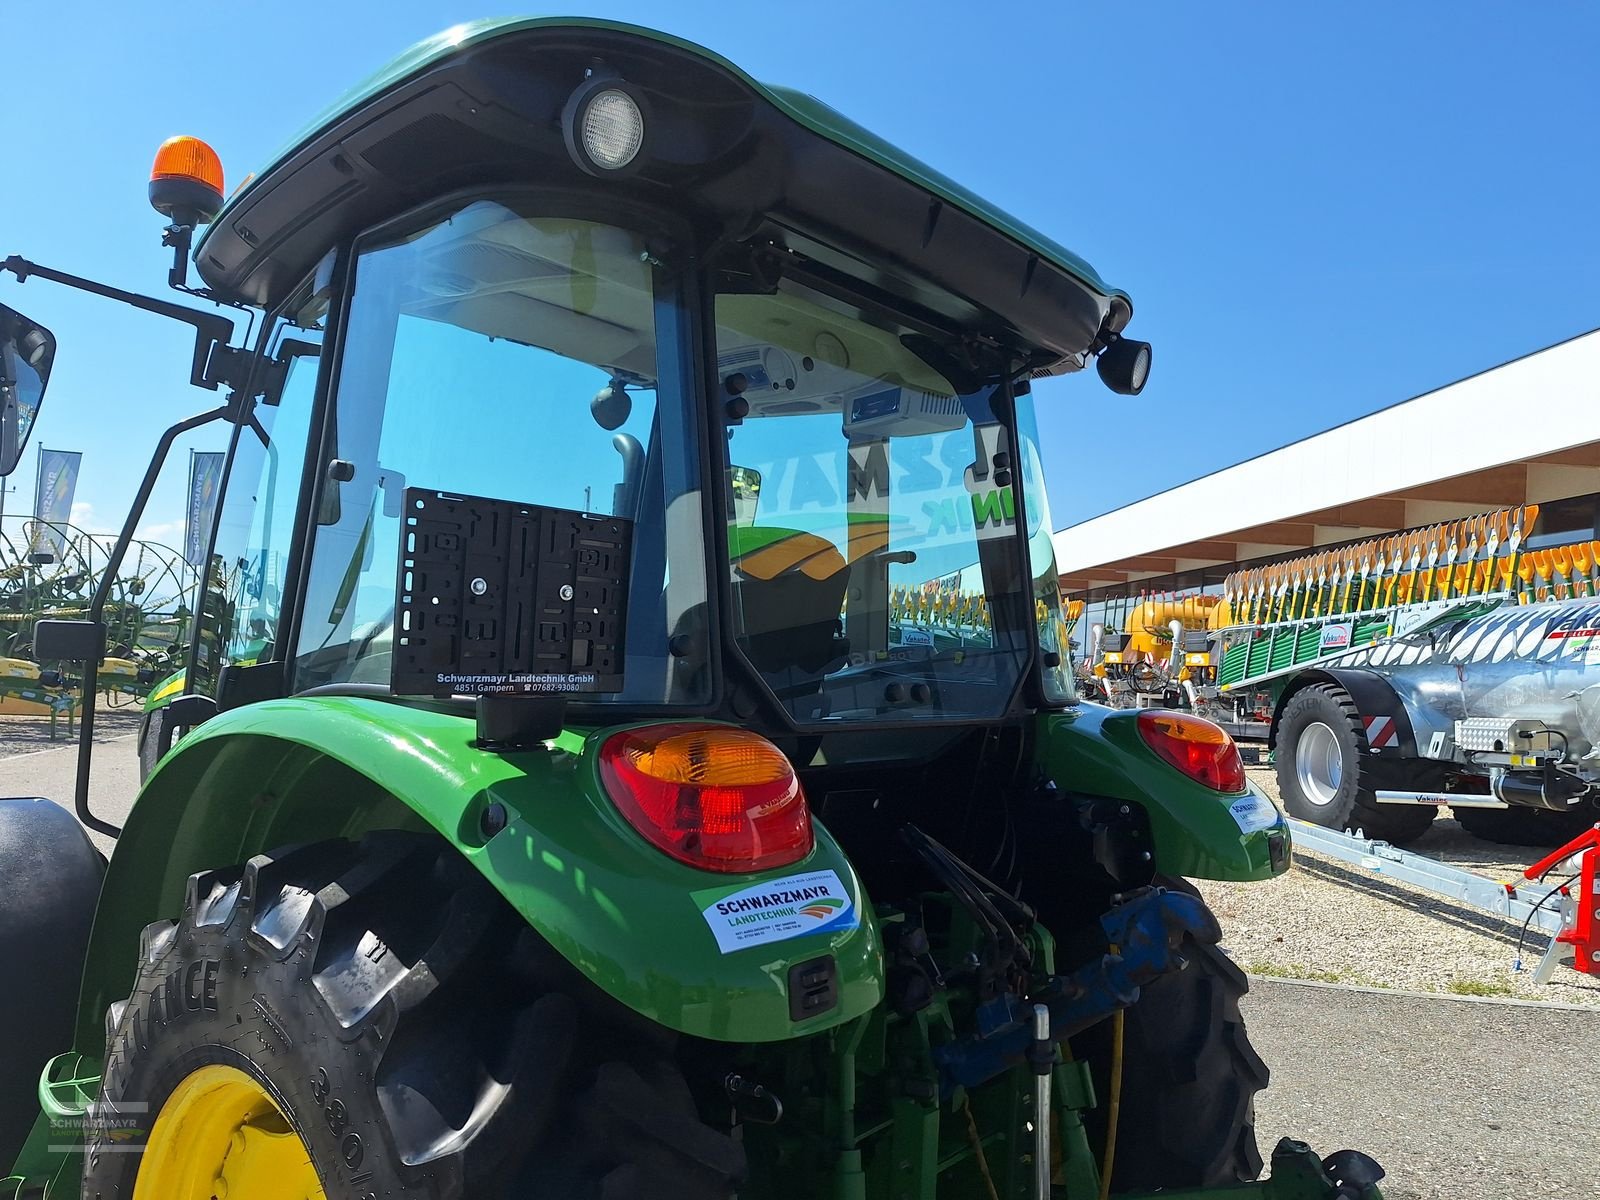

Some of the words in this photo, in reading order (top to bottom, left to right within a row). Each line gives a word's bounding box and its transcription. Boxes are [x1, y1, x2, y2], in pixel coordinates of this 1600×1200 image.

[192, 473, 204, 552] SCHWARZMAYR
[1323, 632, 1347, 643] Vakutec
[436, 673, 507, 684] Schwarzmayr
[509, 673, 566, 683] Landtechnik
[568, 674, 594, 683] GmbH
[454, 684, 474, 692] 4851
[477, 684, 514, 693] Gampern
[532, 683, 580, 692] 07682-93080
[716, 885, 831, 915] SCHWARZMAYR
[727, 906, 798, 927] LANDTECHNIK
